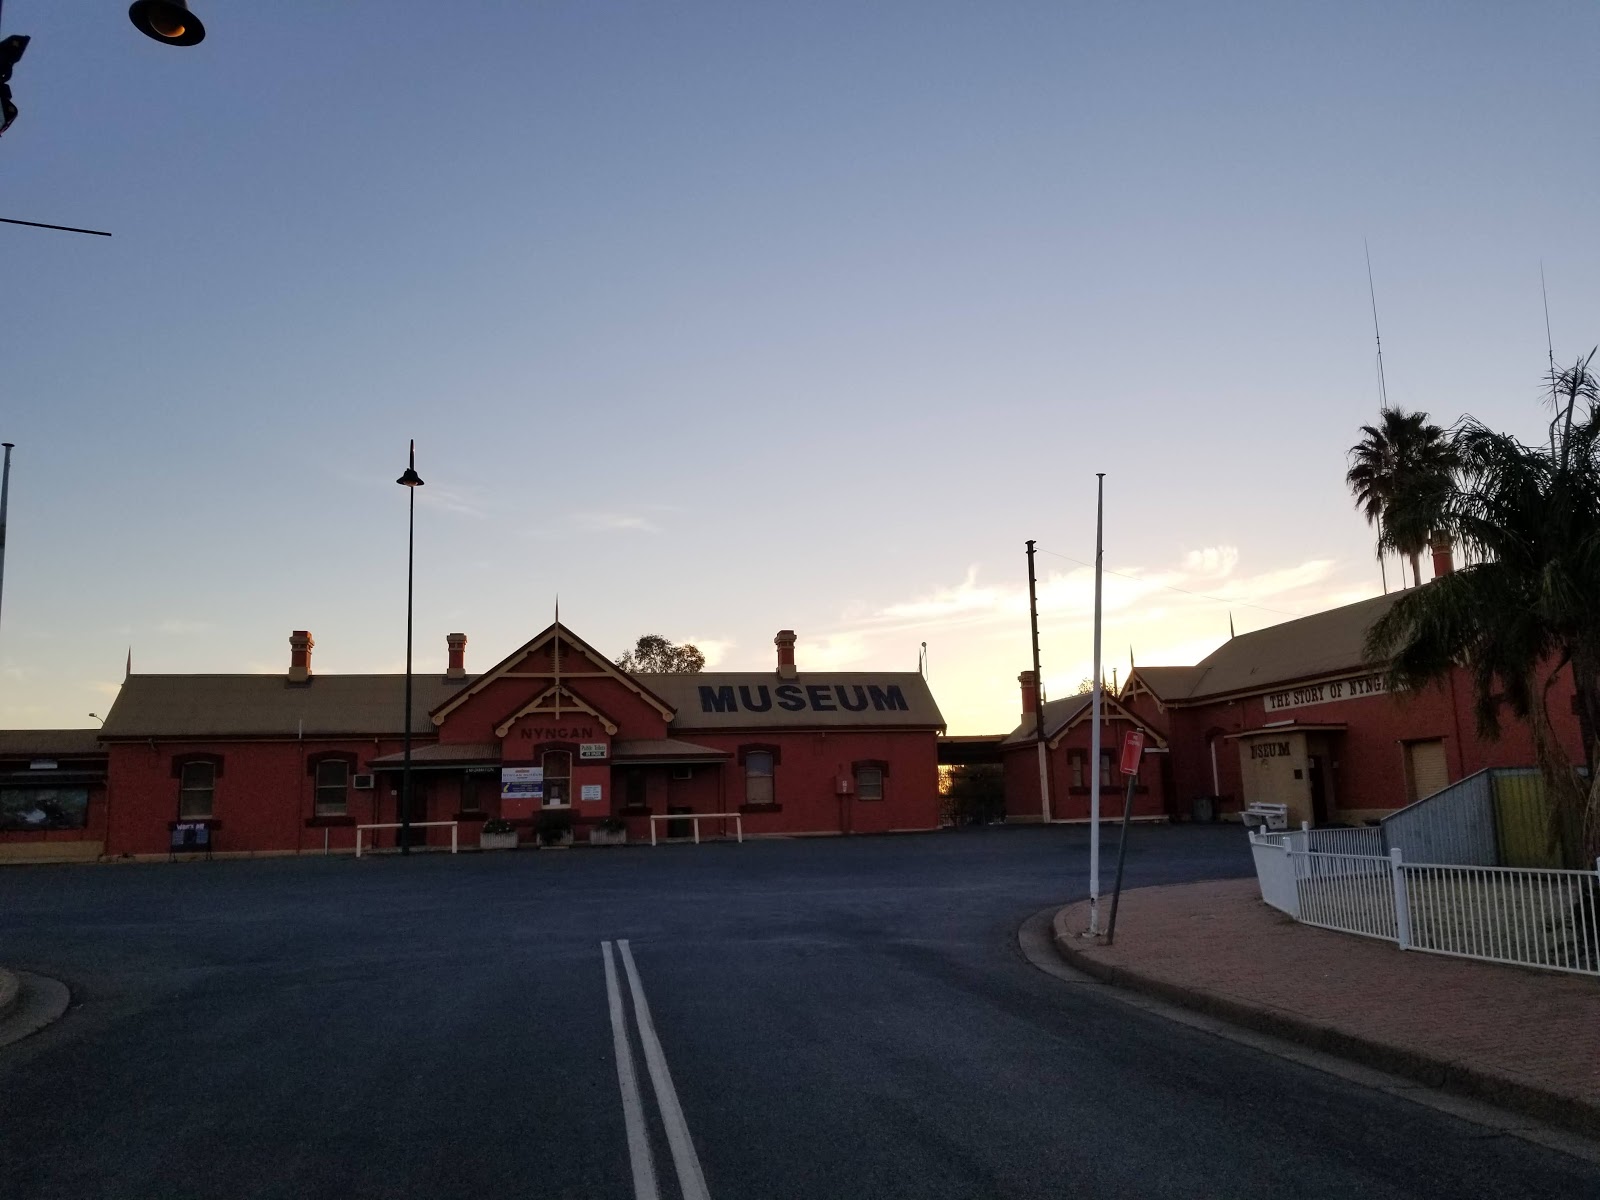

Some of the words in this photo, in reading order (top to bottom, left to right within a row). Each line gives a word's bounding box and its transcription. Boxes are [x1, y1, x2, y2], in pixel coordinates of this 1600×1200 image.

[698, 685, 909, 712] MUSEUM
[1269, 692, 1291, 709] THE
[1293, 686, 1325, 706] STORY
[1329, 682, 1344, 699] OF
[520, 727, 593, 740] NYNGAN
